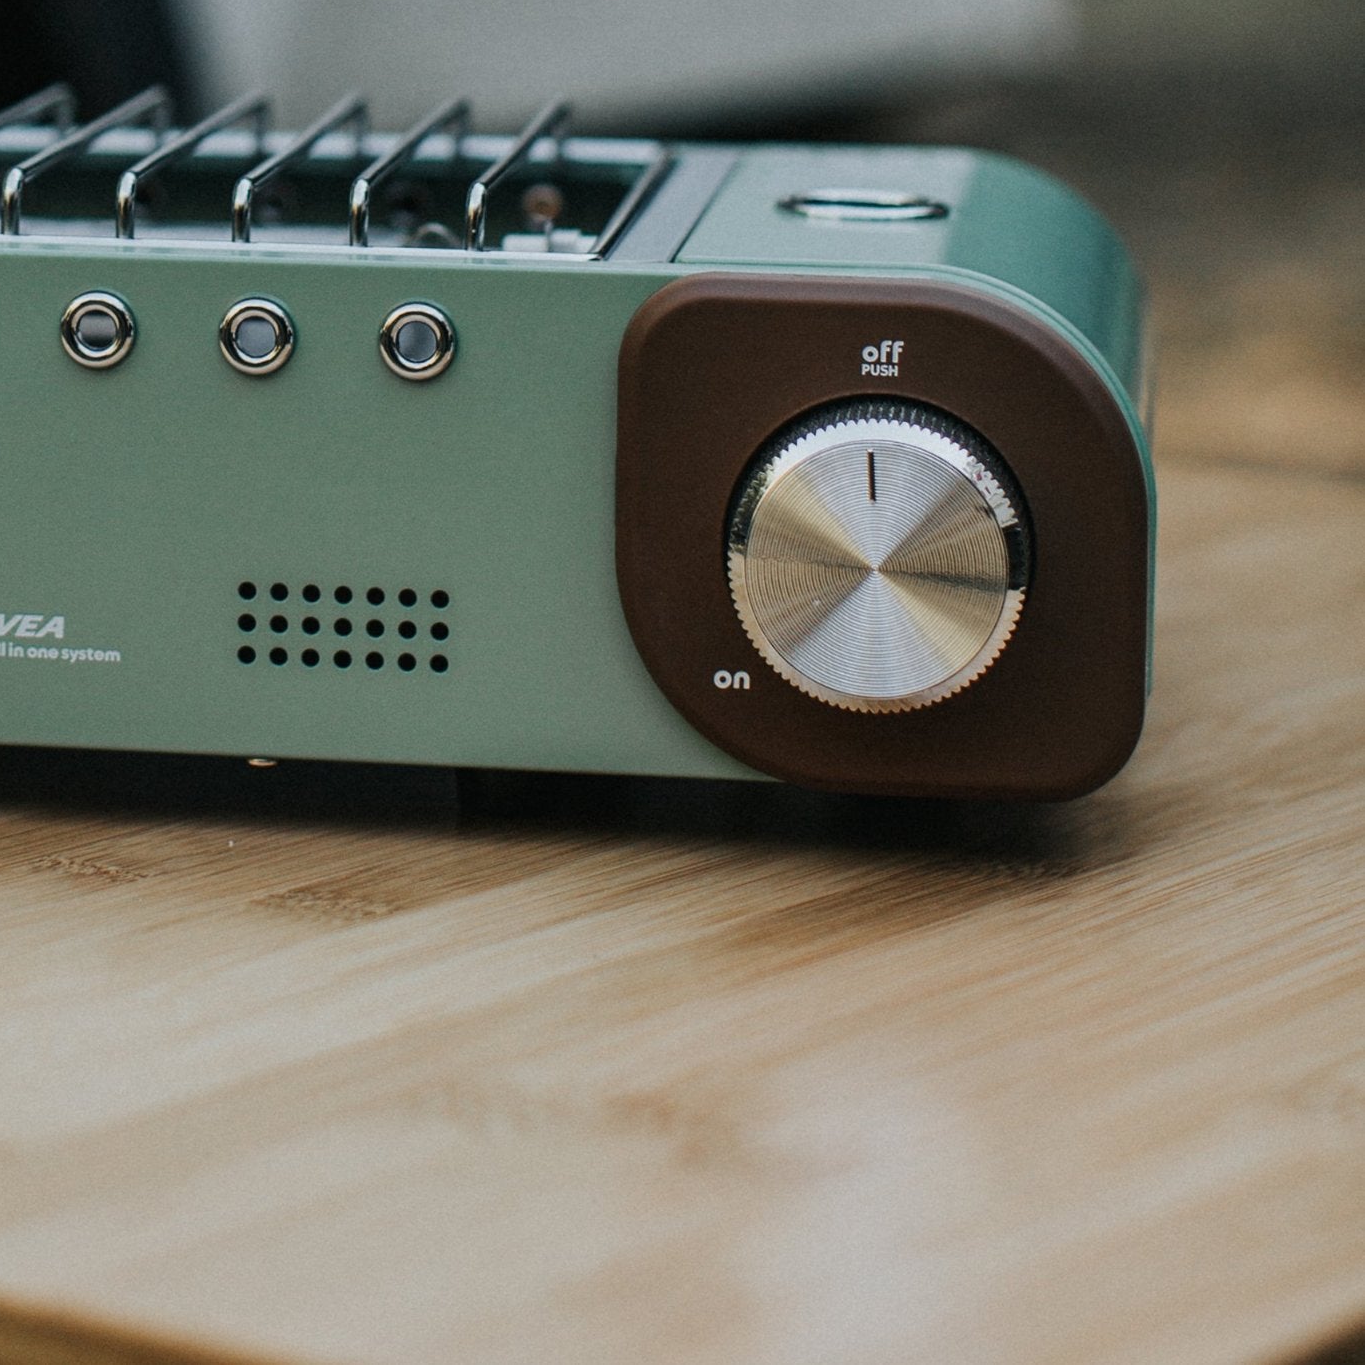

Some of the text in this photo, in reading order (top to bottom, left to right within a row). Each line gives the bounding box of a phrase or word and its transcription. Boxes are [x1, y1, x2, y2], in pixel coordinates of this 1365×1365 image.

[862, 340, 904, 363] off
[861, 364, 898, 377] PUSH
[8, 643, 24, 657] in
[27, 647, 59, 660] one
[61, 647, 121, 663] system
[714, 670, 750, 689] on
